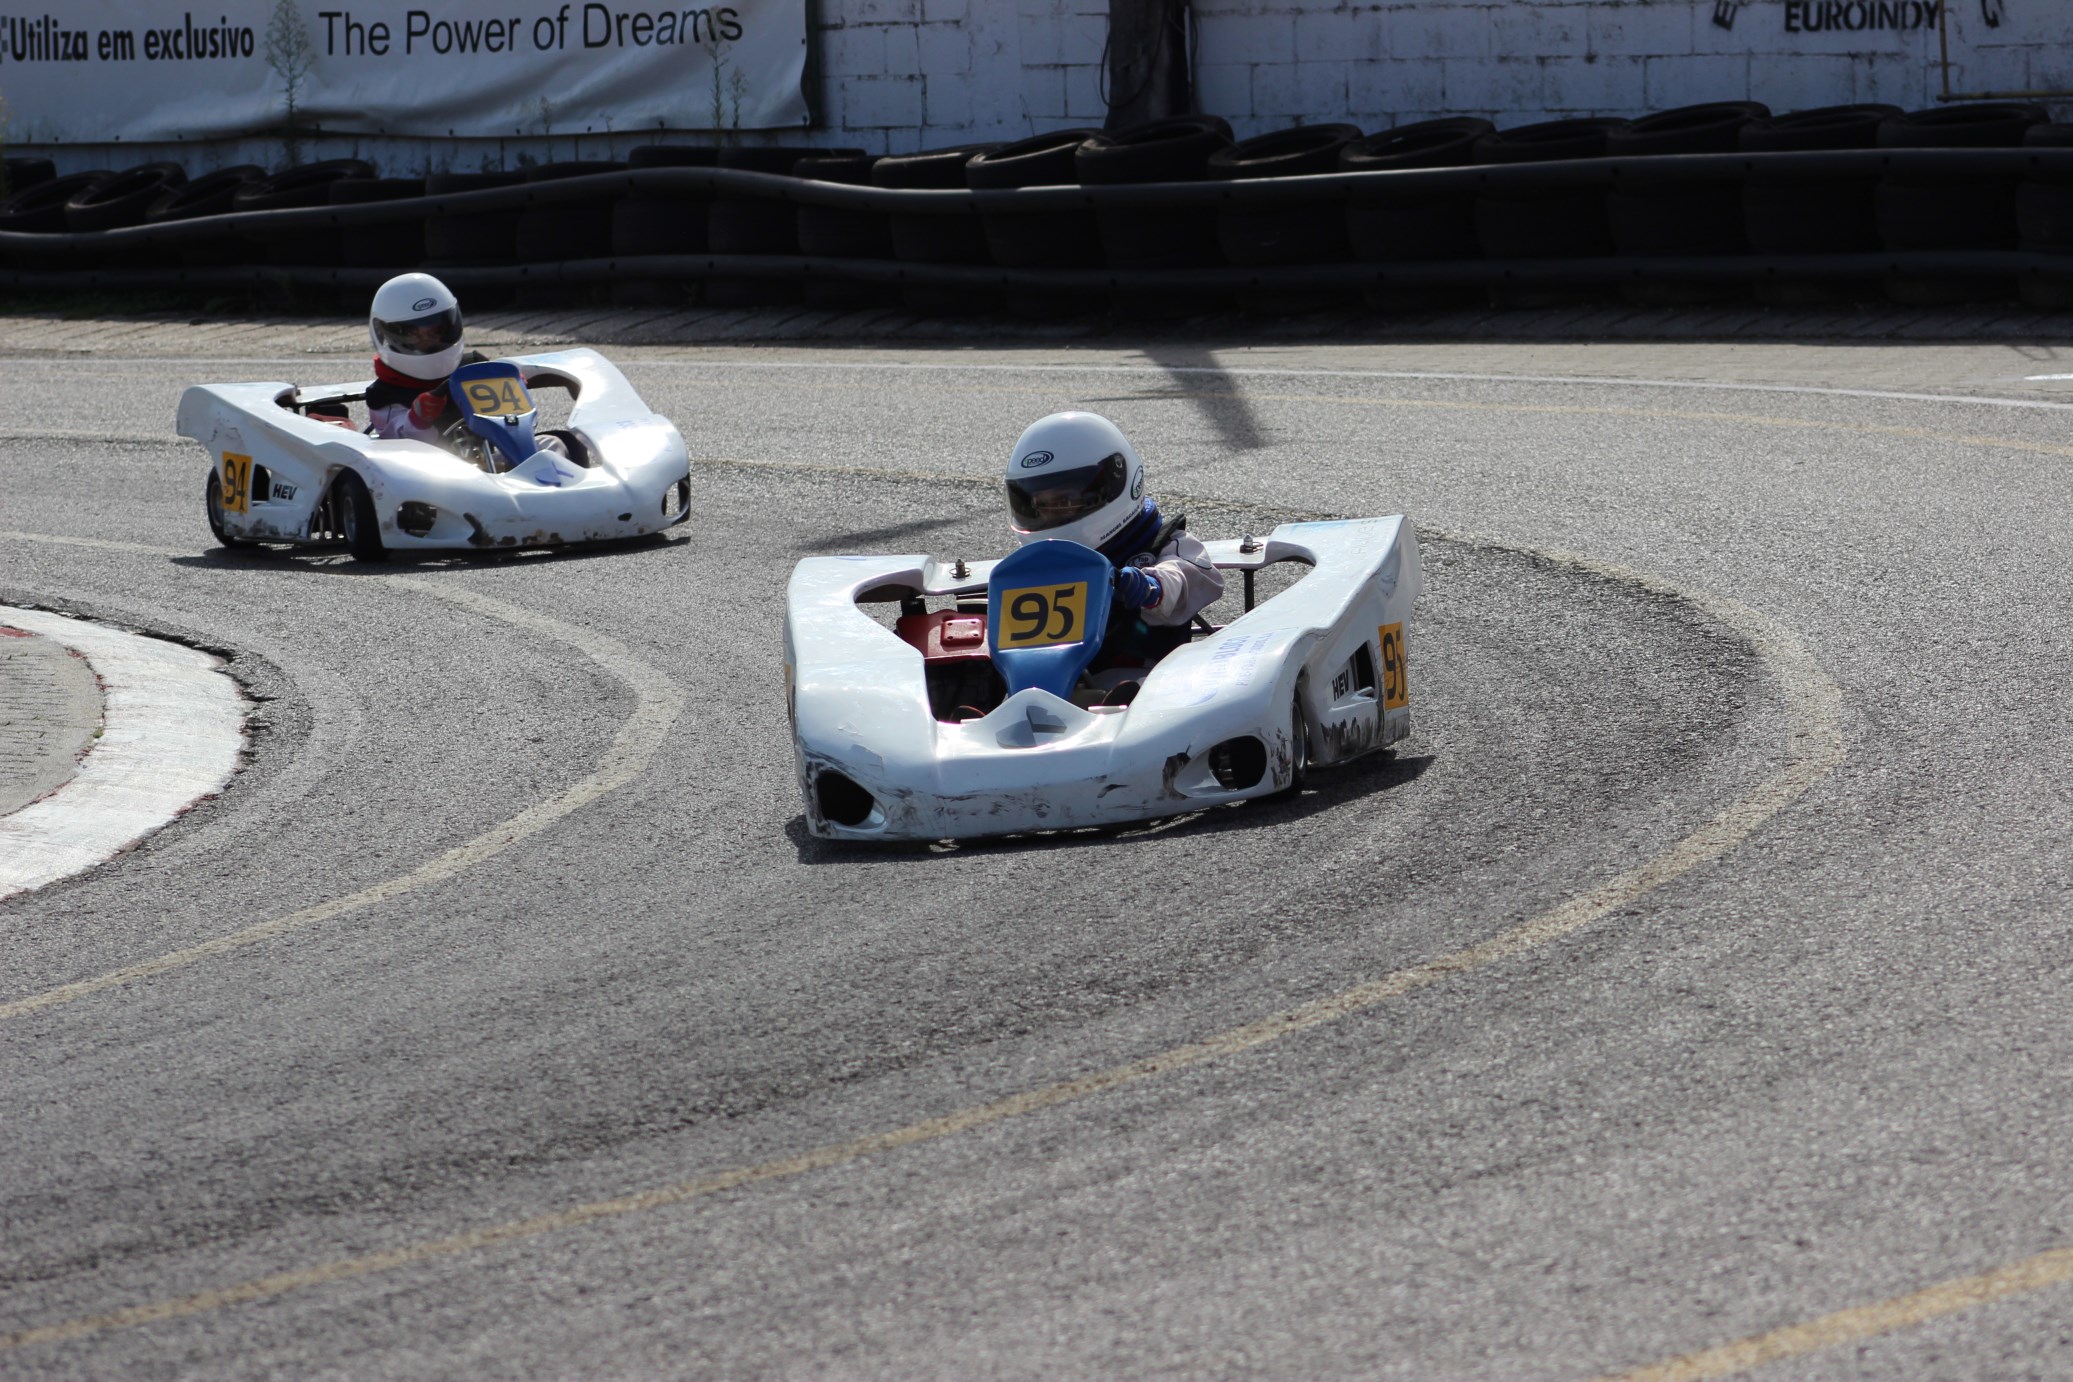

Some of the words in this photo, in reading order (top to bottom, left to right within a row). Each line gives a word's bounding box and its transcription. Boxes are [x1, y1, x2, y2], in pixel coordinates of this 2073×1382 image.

[10, 14, 88, 62] Utiliza
[97, 29, 135, 61] em
[144, 12, 255, 60] exclusivo
[318, 11, 391, 56] The
[405, 9, 521, 55] Power
[532, 4, 571, 51] of
[583, 2, 744, 48] Dreams
[1785, 0, 1939, 33] EUROINDY
[469, 381, 524, 413] 94
[224, 458, 247, 515] 94
[273, 483, 298, 501] HEV
[1010, 584, 1076, 642] 95
[1332, 669, 1349, 702] HEV
[1383, 628, 1404, 702] 95
